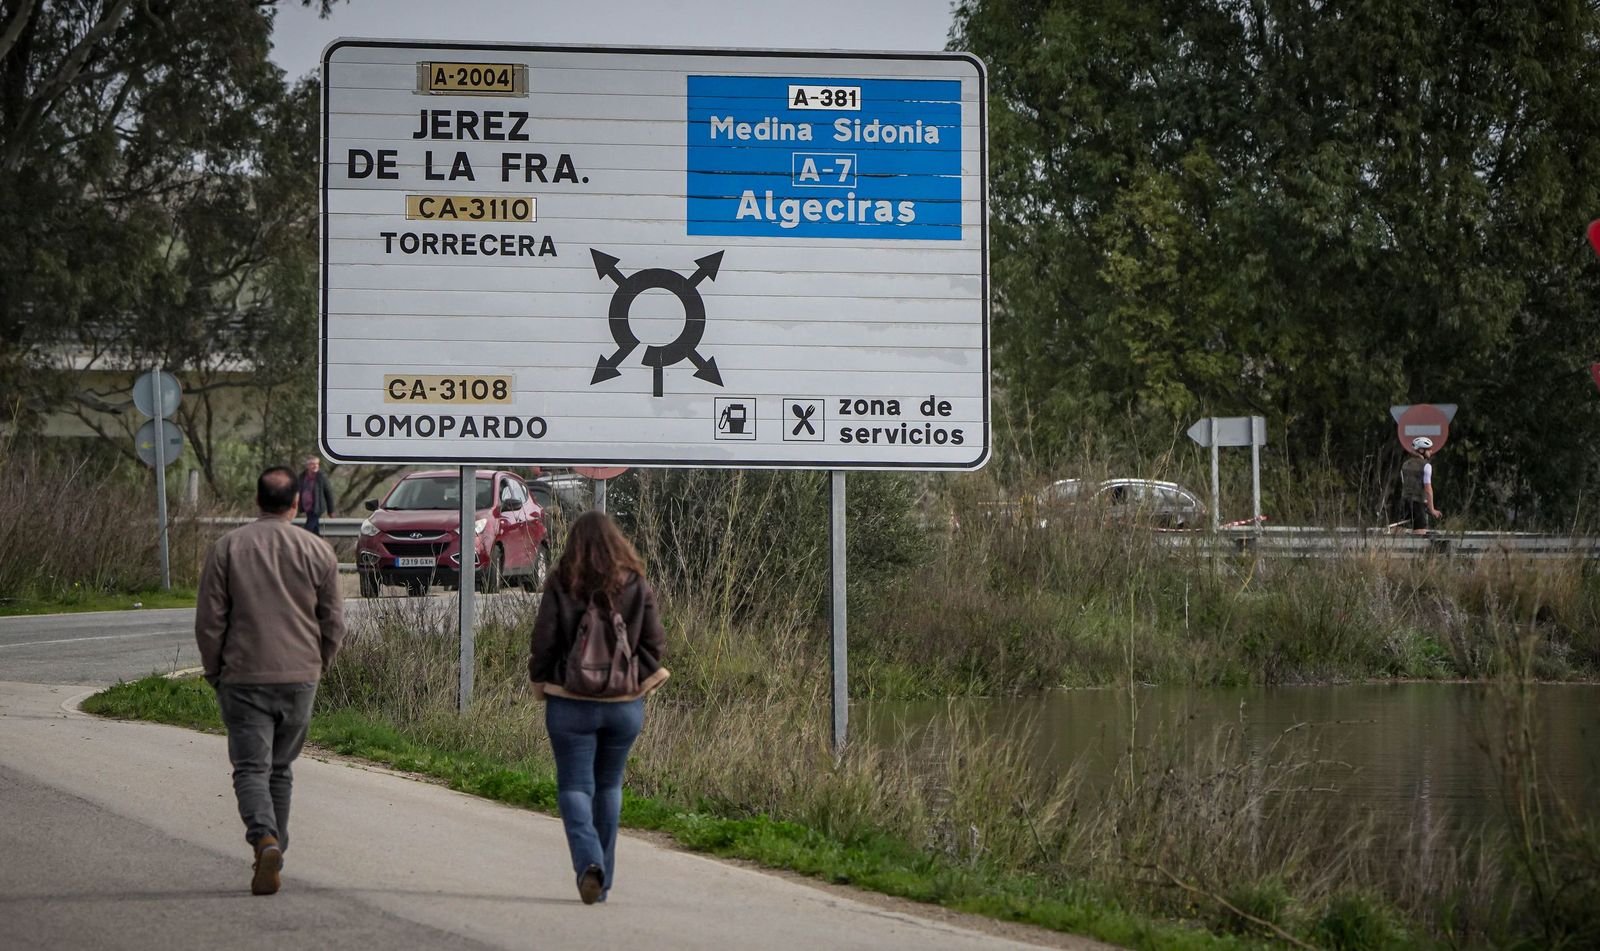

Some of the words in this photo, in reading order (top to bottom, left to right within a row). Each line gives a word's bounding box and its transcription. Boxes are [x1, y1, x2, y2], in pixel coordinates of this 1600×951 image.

[434, 67, 509, 87] A-2004
[793, 88, 857, 108] A-381
[412, 109, 530, 141] JEREZ
[710, 115, 813, 141] Medina
[833, 117, 940, 144] Sidonia
[347, 148, 399, 180] DE
[425, 150, 476, 181] LA
[501, 152, 589, 184] FRA.
[799, 158, 852, 182] A-7
[418, 197, 529, 220] CA-3110
[735, 190, 916, 228] Algeciras
[380, 232, 558, 257] TORRECERA
[388, 378, 508, 401] CA-3108
[838, 398, 901, 416] zona
[919, 394, 952, 417] de
[346, 414, 548, 439] LOMOPARDO
[838, 422, 964, 445] servicios
[401, 558, 419, 566] 2319
